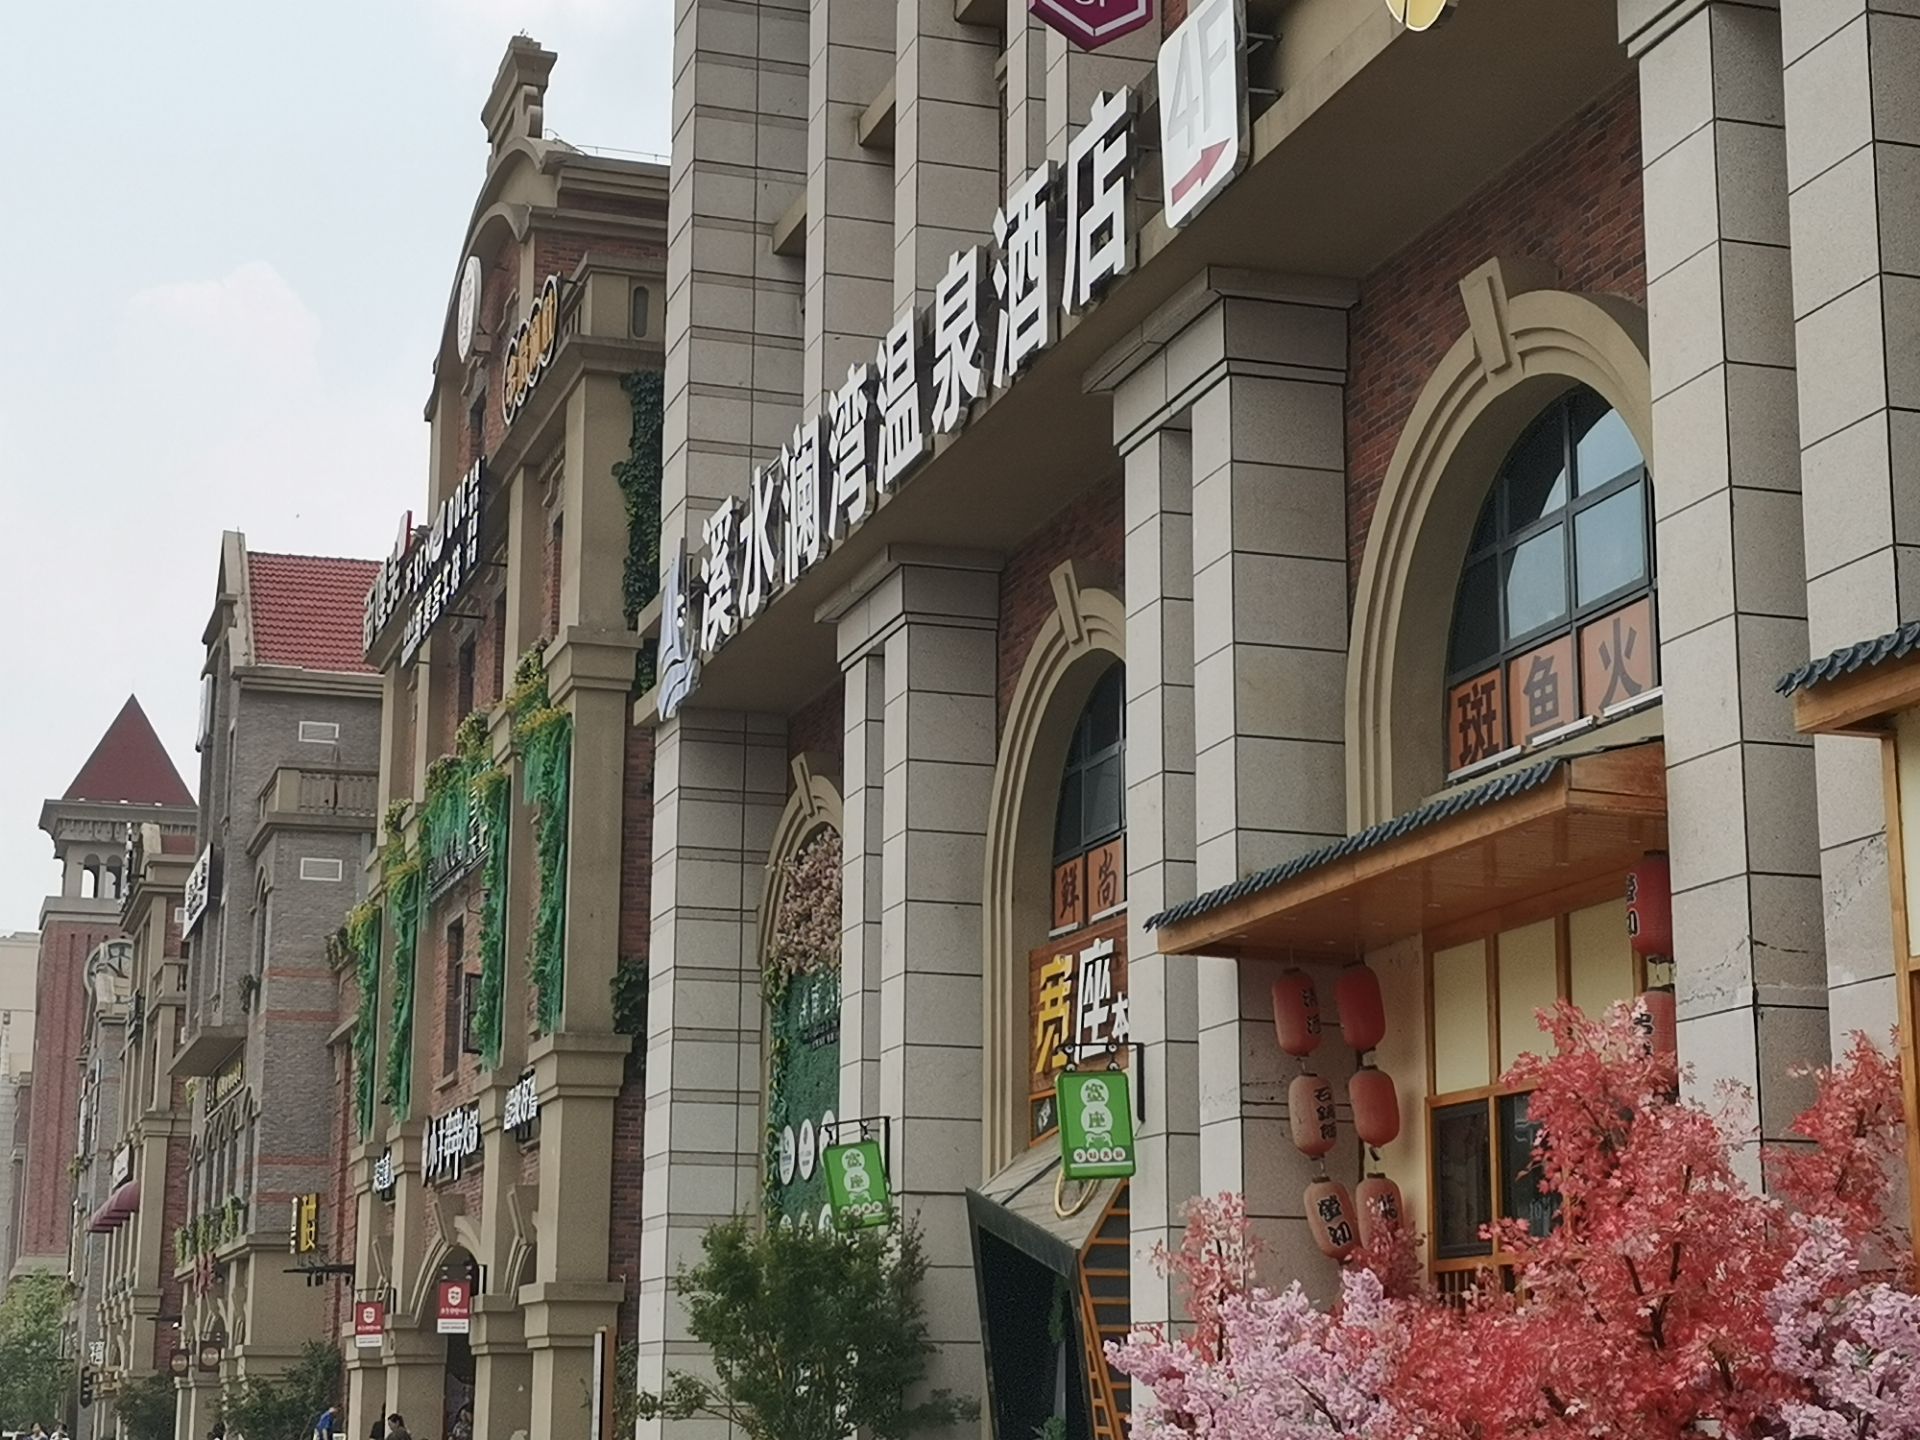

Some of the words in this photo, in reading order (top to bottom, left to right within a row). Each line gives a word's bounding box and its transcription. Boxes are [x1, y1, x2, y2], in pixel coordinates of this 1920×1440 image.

[1167, 0, 1231, 149] 4F
[700, 84, 1129, 653] 溪水澜湾温泉酒店
